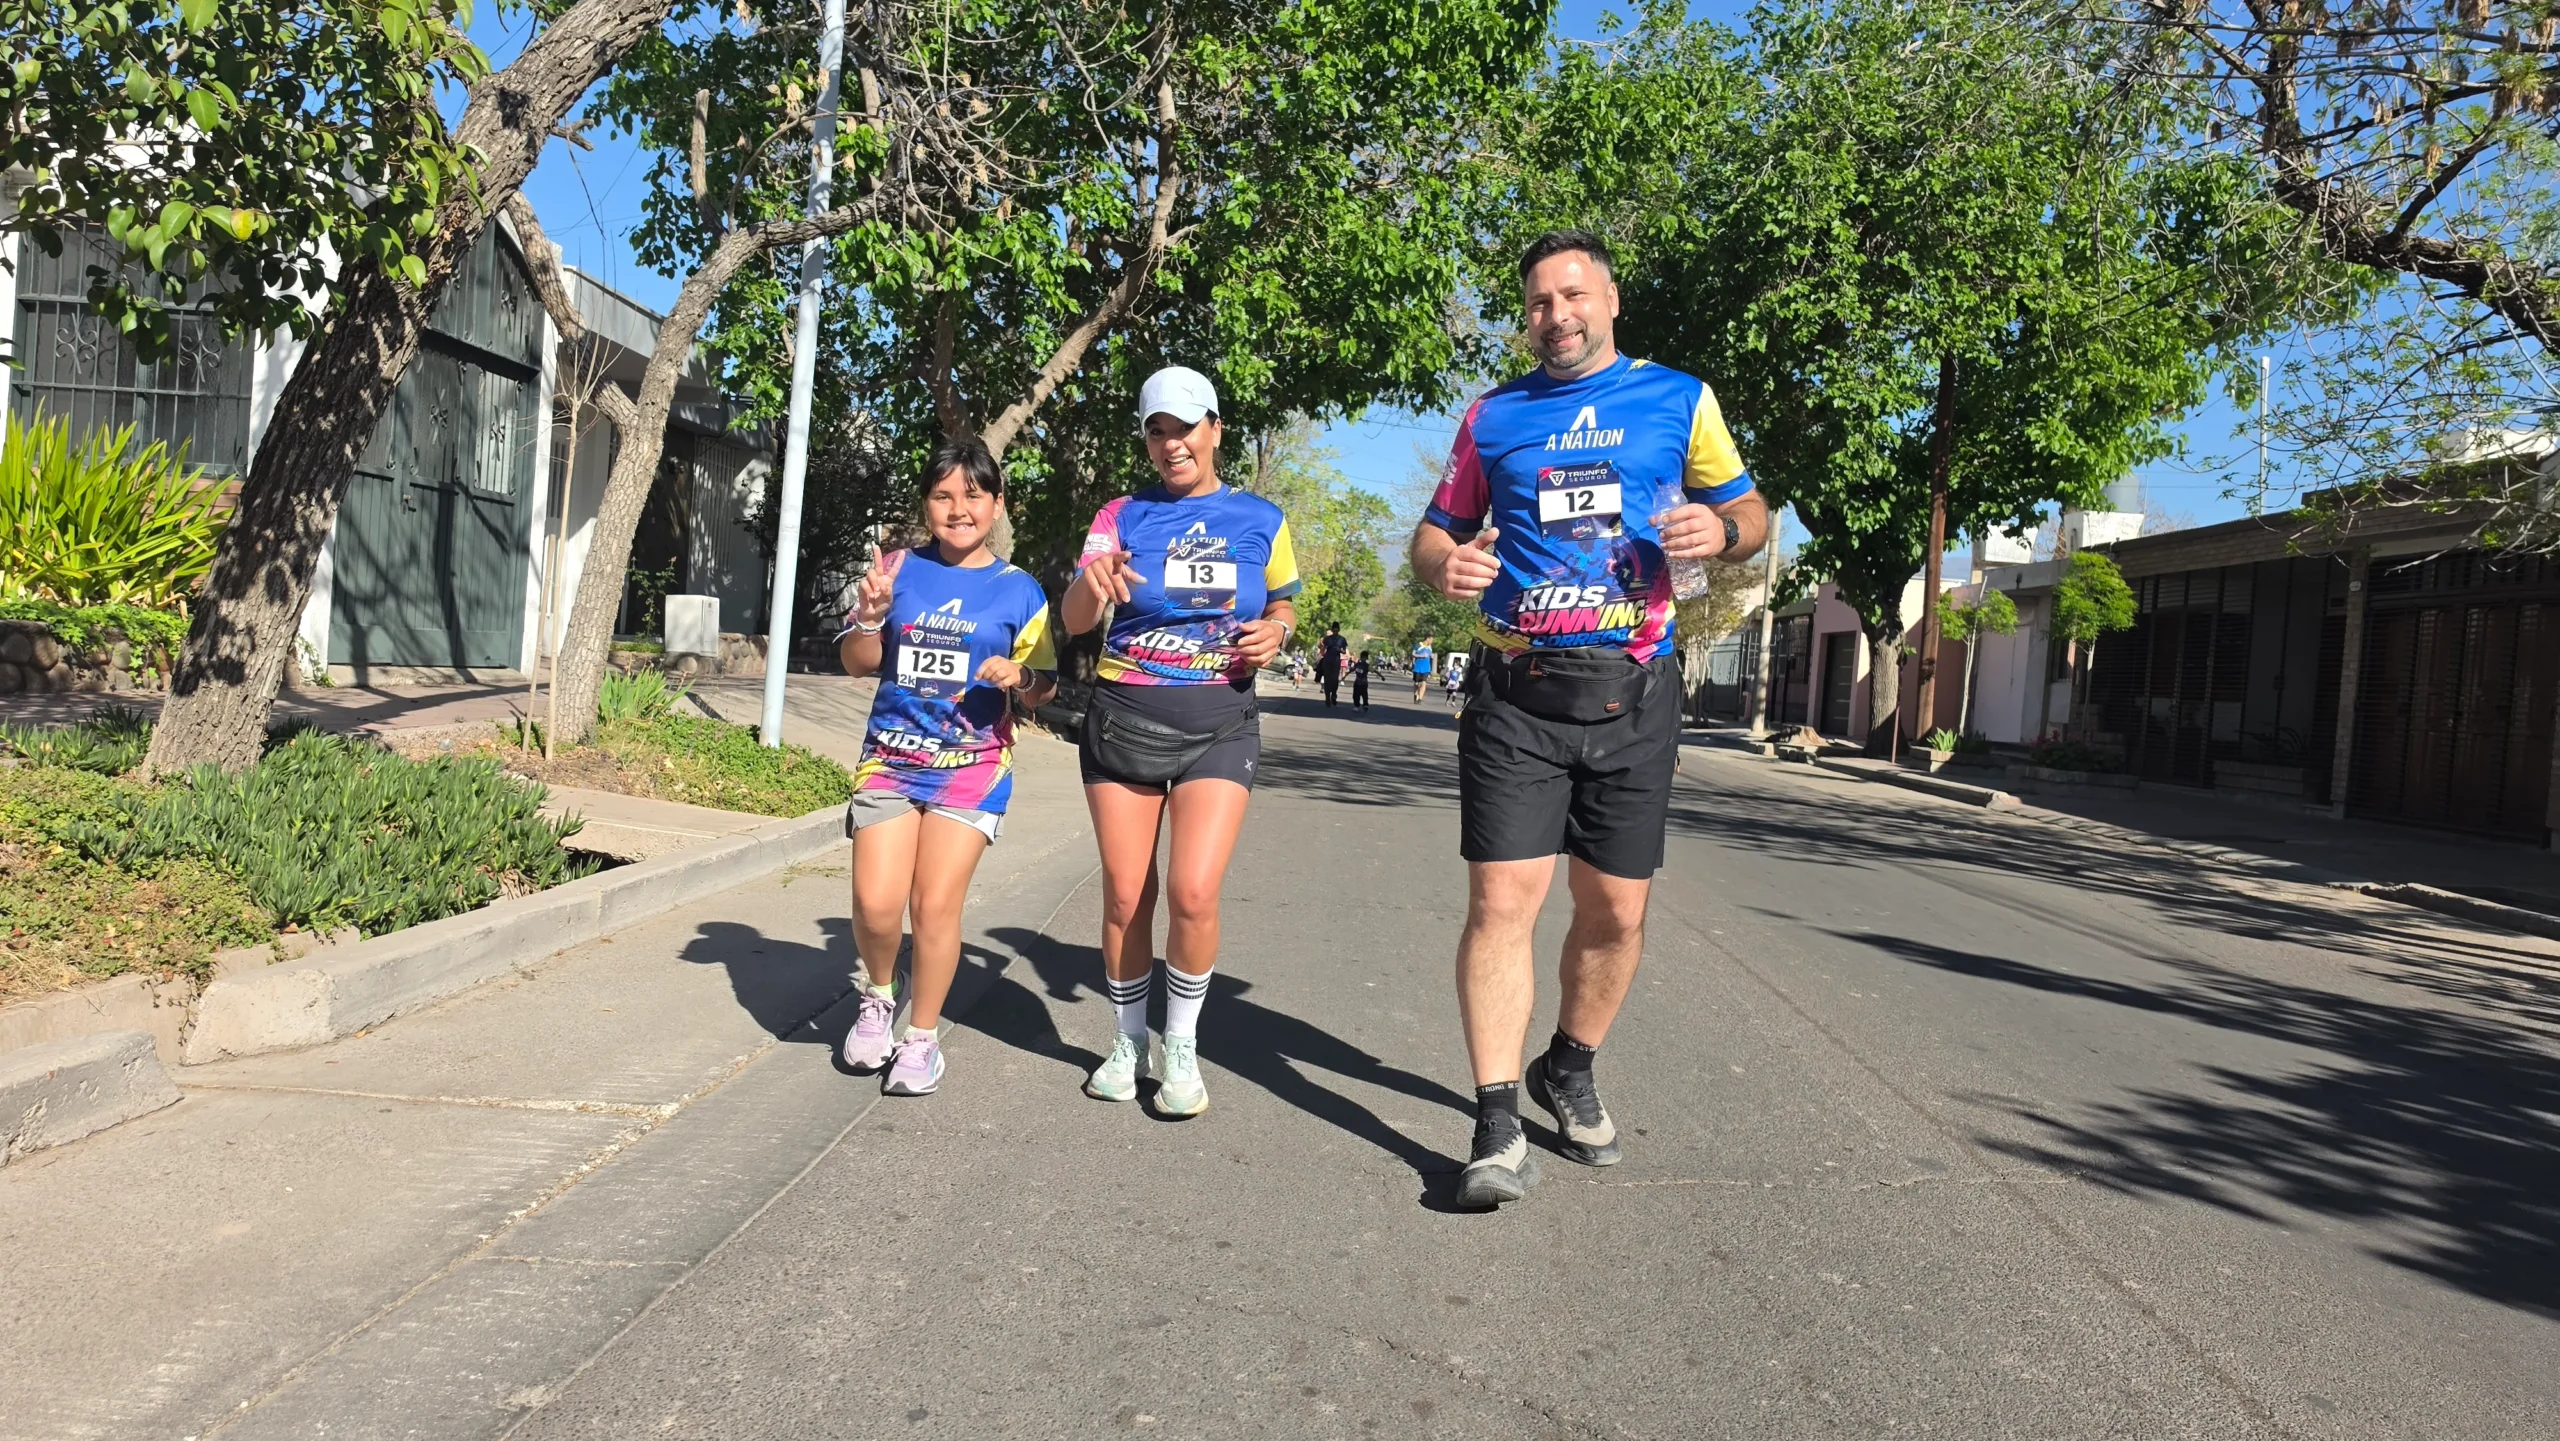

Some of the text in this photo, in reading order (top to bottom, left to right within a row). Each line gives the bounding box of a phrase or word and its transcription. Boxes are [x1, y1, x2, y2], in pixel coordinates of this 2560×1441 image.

[1544, 428, 1625, 451] A NATION
[1566, 468, 1608, 478] TRIUNFO
[1568, 474, 1607, 483] SEGUROS
[1565, 490, 1595, 513] 12
[1166, 537, 1177, 550] A
[1188, 564, 1214, 584] 13
[1518, 585, 1608, 613] KIDS
[913, 611, 978, 633] A NATION
[1518, 599, 1646, 634] RUNNING
[925, 632, 962, 643] TRIUNFO
[926, 639, 960, 647] SEGUROS
[1129, 631, 1204, 654] KIDS
[912, 650, 955, 676] 125
[1128, 645, 1232, 670] RUNNING
[877, 730, 943, 753] KIDS
